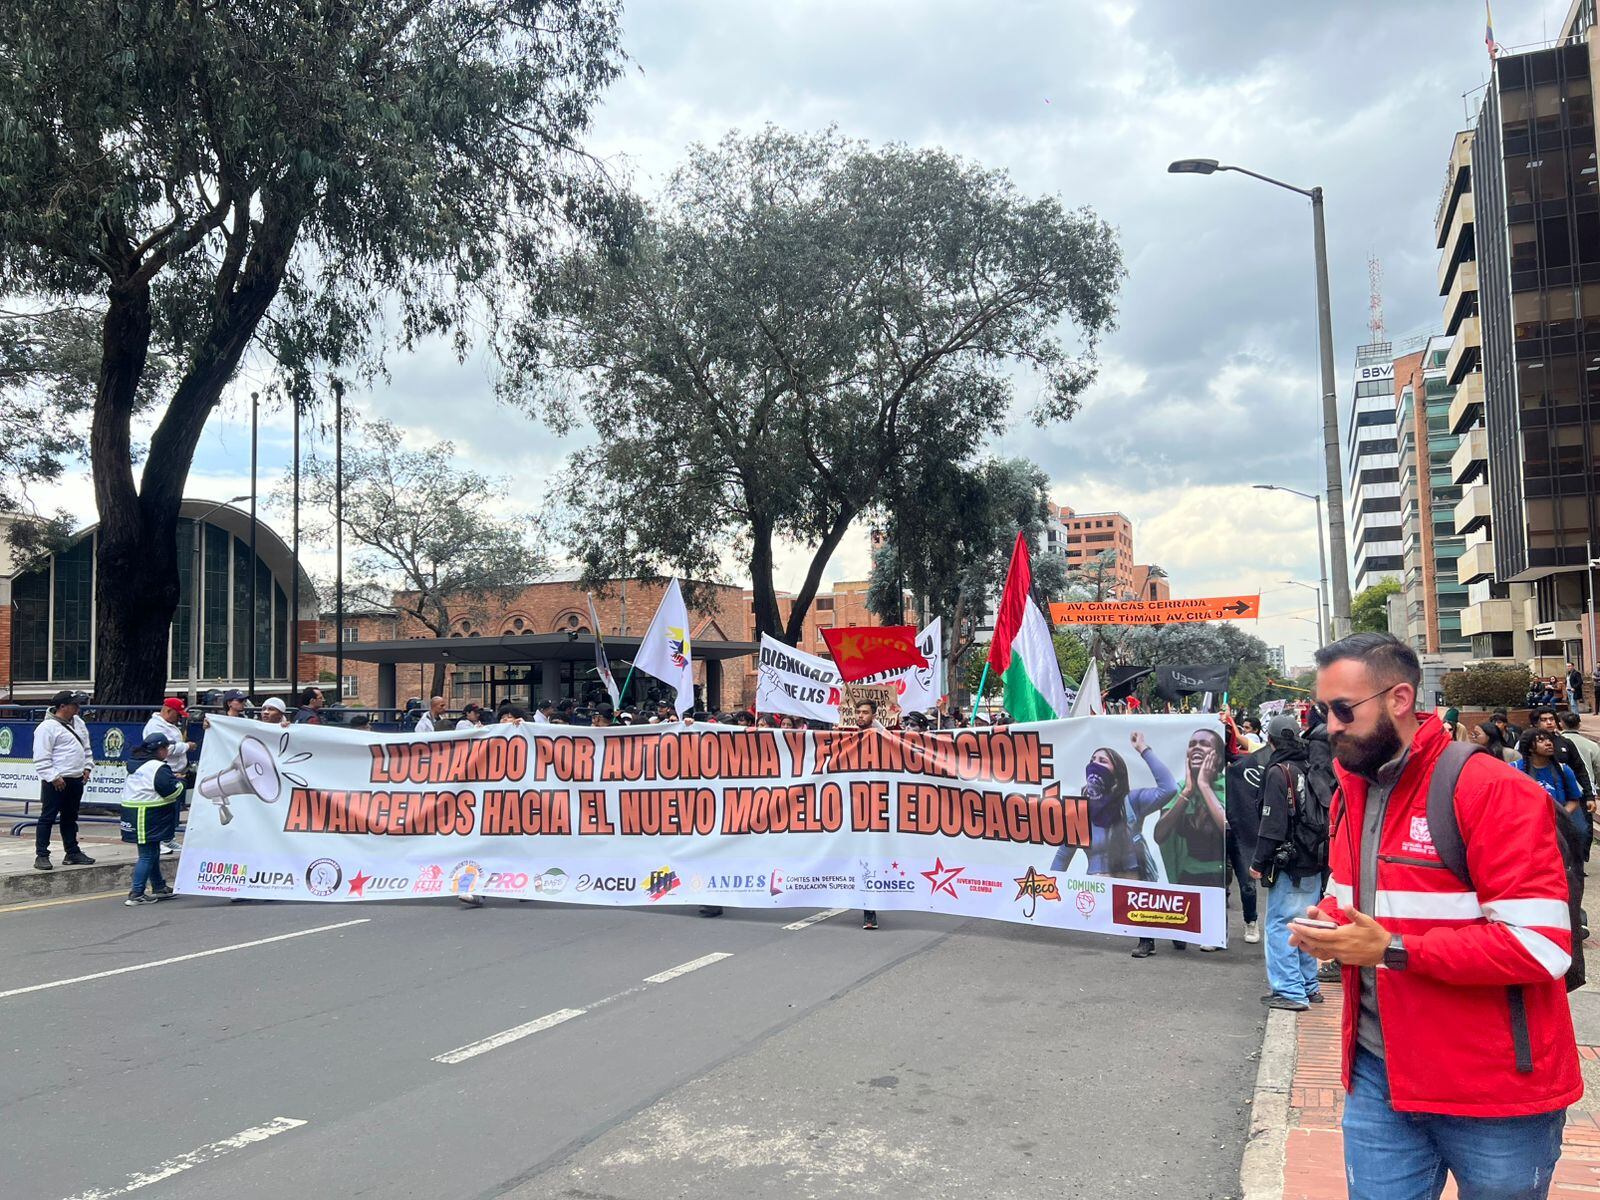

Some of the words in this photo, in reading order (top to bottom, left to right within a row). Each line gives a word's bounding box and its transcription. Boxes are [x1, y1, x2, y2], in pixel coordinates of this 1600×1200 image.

[1088, 602, 1144, 611] CARACAS
[1148, 600, 1206, 609] CERRADA
[1077, 614, 1115, 622] NORTE
[1167, 613, 1184, 621] AV.
[1186, 612, 1211, 620] CRA
[1216, 610, 1223, 618] 9
[761, 647, 834, 683] DIGNIDAD
[784, 683, 798, 699] DE
[799, 687, 825, 703] LXS
[369, 735, 528, 784] LUCHANDO
[534, 736, 595, 782] POR
[783, 731, 806, 777] Y
[812, 726, 1054, 785] FINANCIACIÓN:
[283, 787, 476, 836] AVANCEMOS
[480, 789, 572, 836] HACIA
[578, 789, 615, 835] EL
[619, 787, 716, 836] NUEVO
[720, 781, 843, 835] MODELO
[849, 781, 890, 832] DE
[897, 781, 1092, 849] EDUCACIÓN
[199, 861, 248, 875] COLOMBIA
[249, 872, 294, 885] JUPA
[367, 877, 409, 889] JUCO
[483, 872, 528, 889] PRO
[593, 877, 636, 891] ACEU
[707, 875, 766, 888] ANDES
[866, 880, 915, 890] CONSEC
[1067, 879, 1105, 893] COMUNES
[1127, 891, 1184, 912] REUNE
